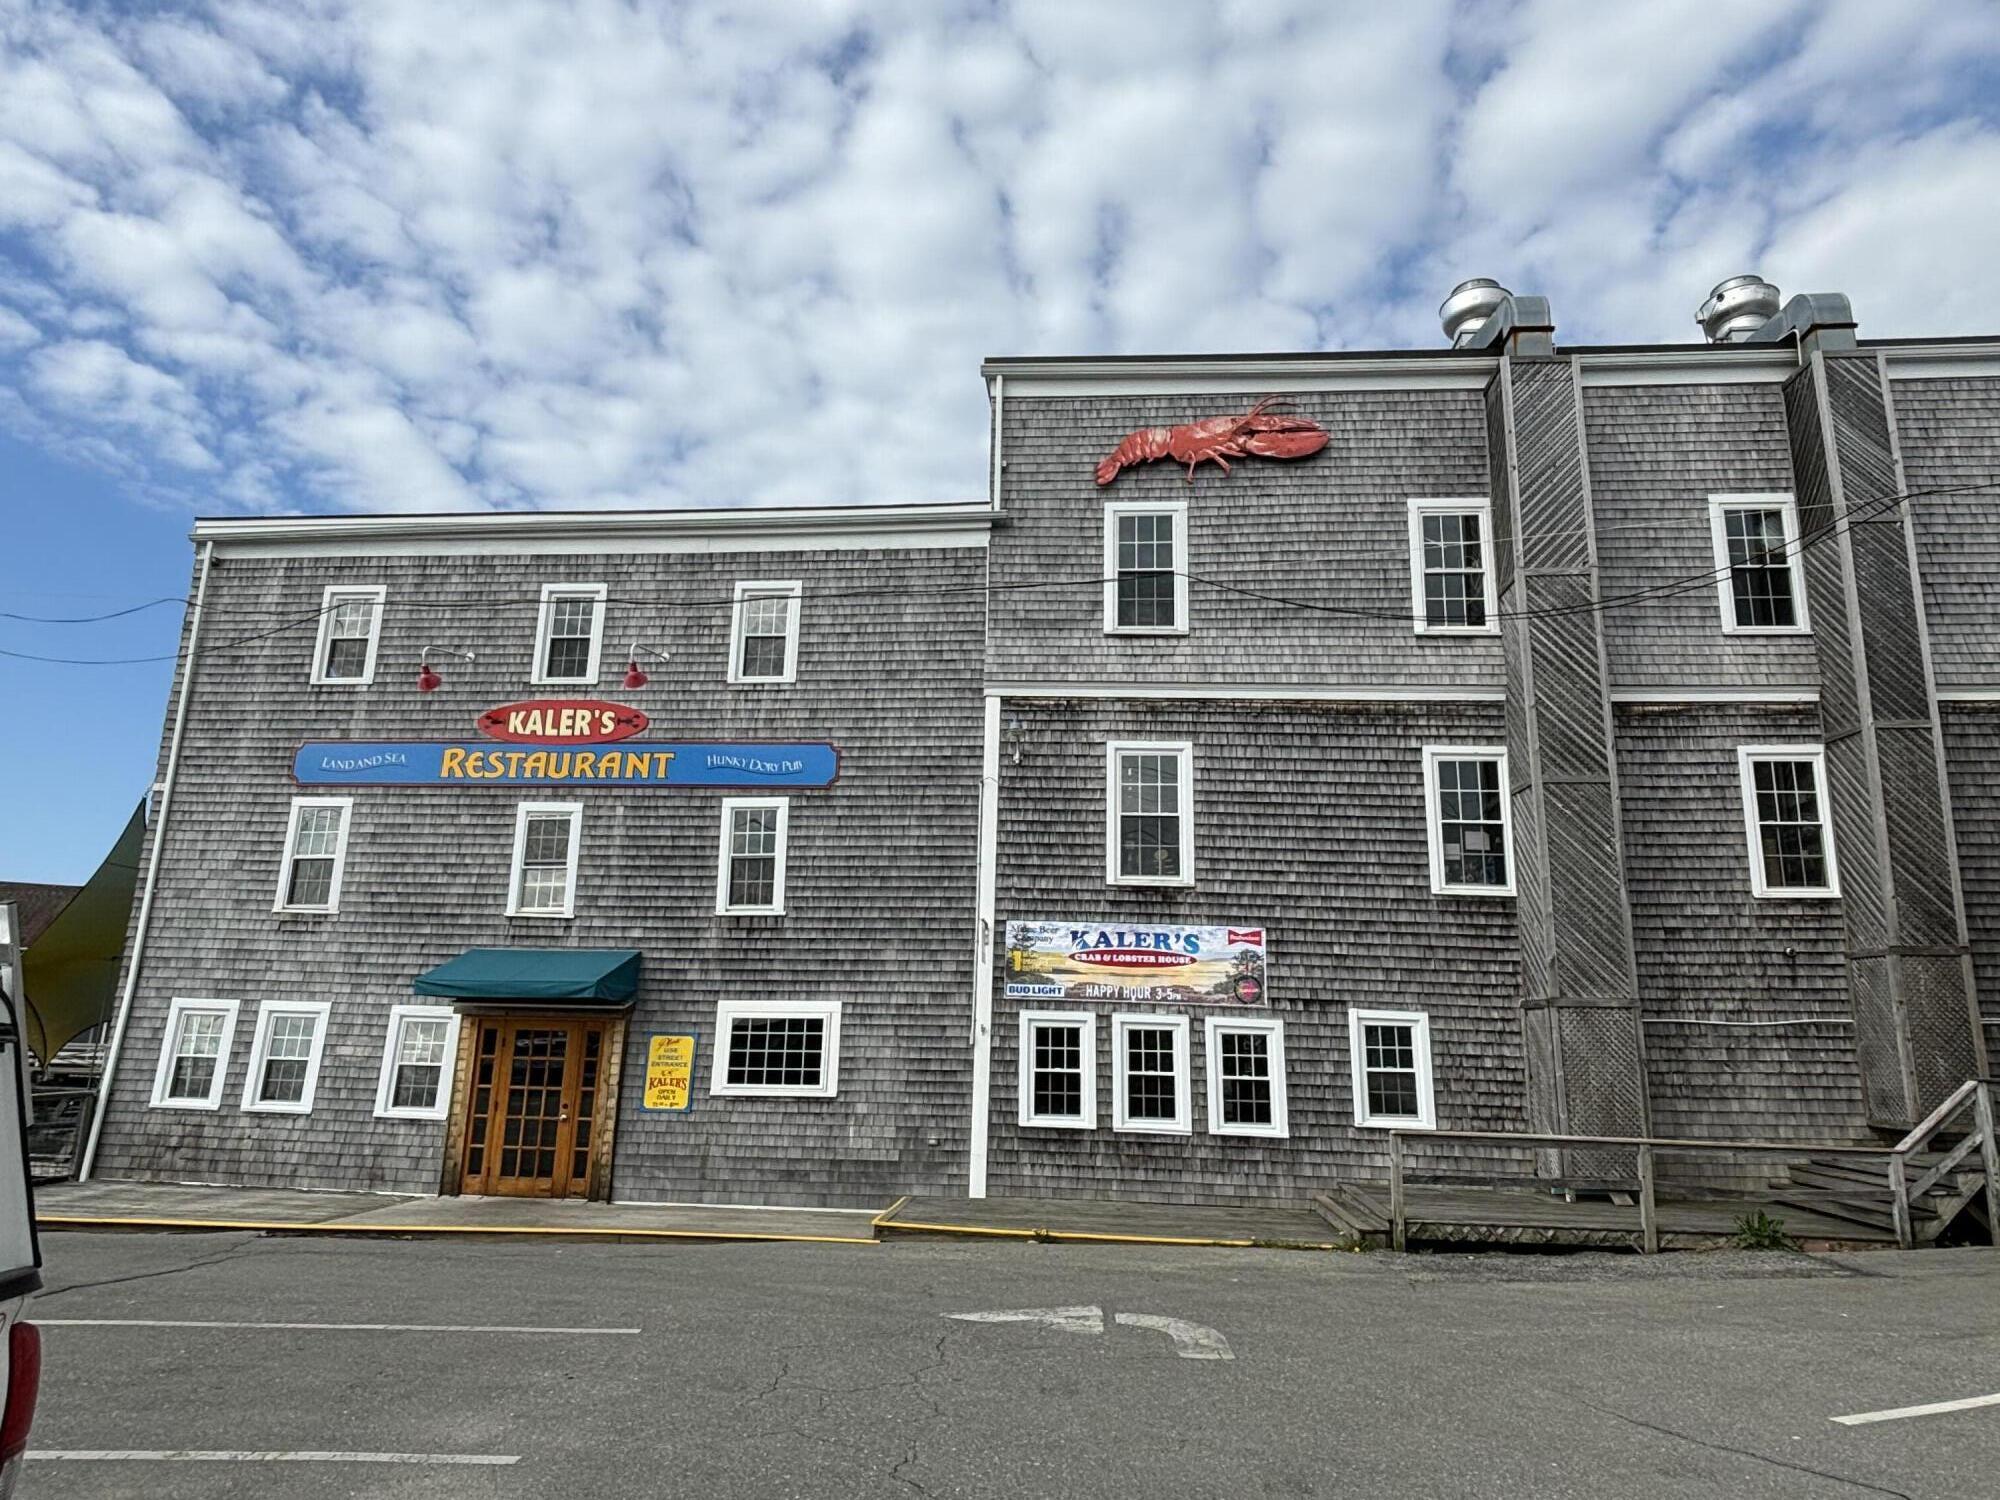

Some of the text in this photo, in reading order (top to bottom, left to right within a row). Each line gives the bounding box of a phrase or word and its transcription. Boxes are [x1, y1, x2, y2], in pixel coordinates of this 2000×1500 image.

[508, 709, 616, 736] KALER'S
[322, 752, 406, 770] LAND AND SEA
[440, 748, 675, 779] RESTAURANT
[707, 754, 802, 772] HUNKY DORY PUB
[1070, 930, 1200, 954] KALER'S
[1074, 953, 1192, 964] CRAB & LOBSTER HOUSE
[1008, 985, 1063, 996] BUD LIGHT
[1086, 984, 1120, 998] HAPPY
[1123, 986, 1151, 1000] HOUR
